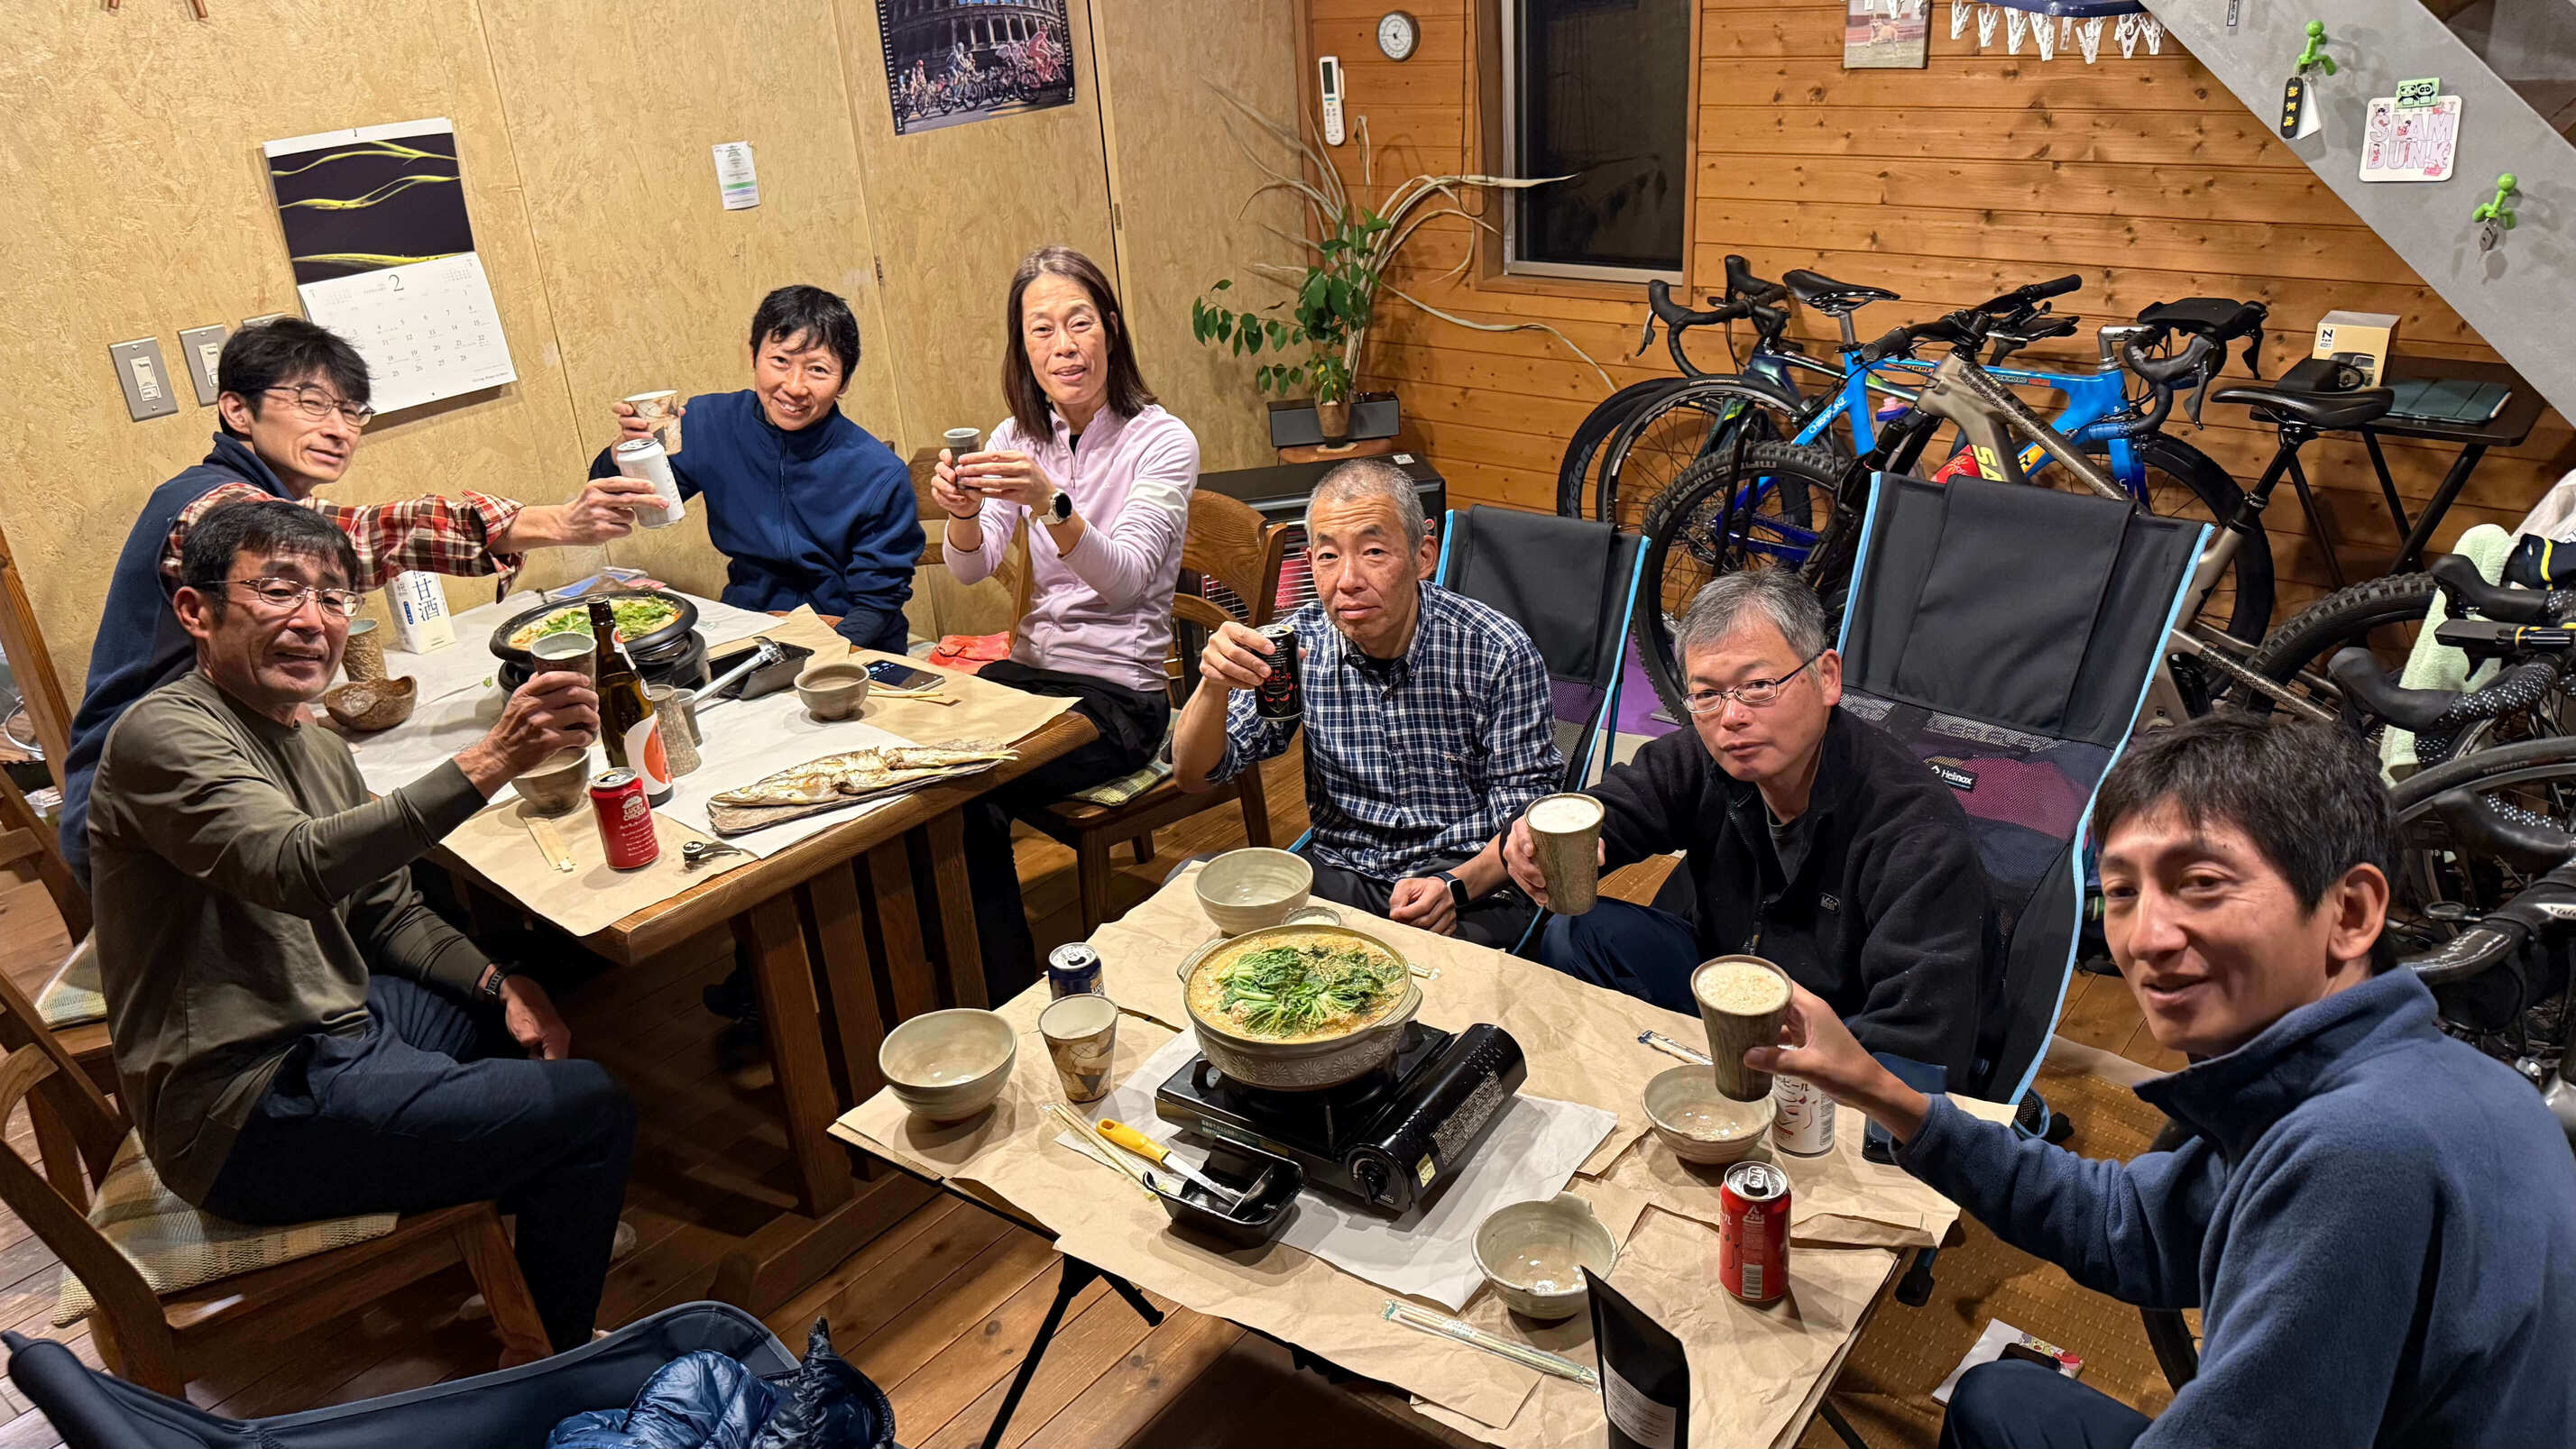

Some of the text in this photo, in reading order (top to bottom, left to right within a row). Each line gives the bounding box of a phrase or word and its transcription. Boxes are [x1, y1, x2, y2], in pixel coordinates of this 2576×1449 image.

[2369, 113, 2456, 142] SLAM
[2366, 142, 2452, 170] DUNK
[388, 274, 404, 292] 2
[2323, 329, 2333, 338] N
[1671, 472, 1714, 509] MARY
[1941, 769, 1973, 785] Helinox
[623, 802, 644, 815] LUCKY
